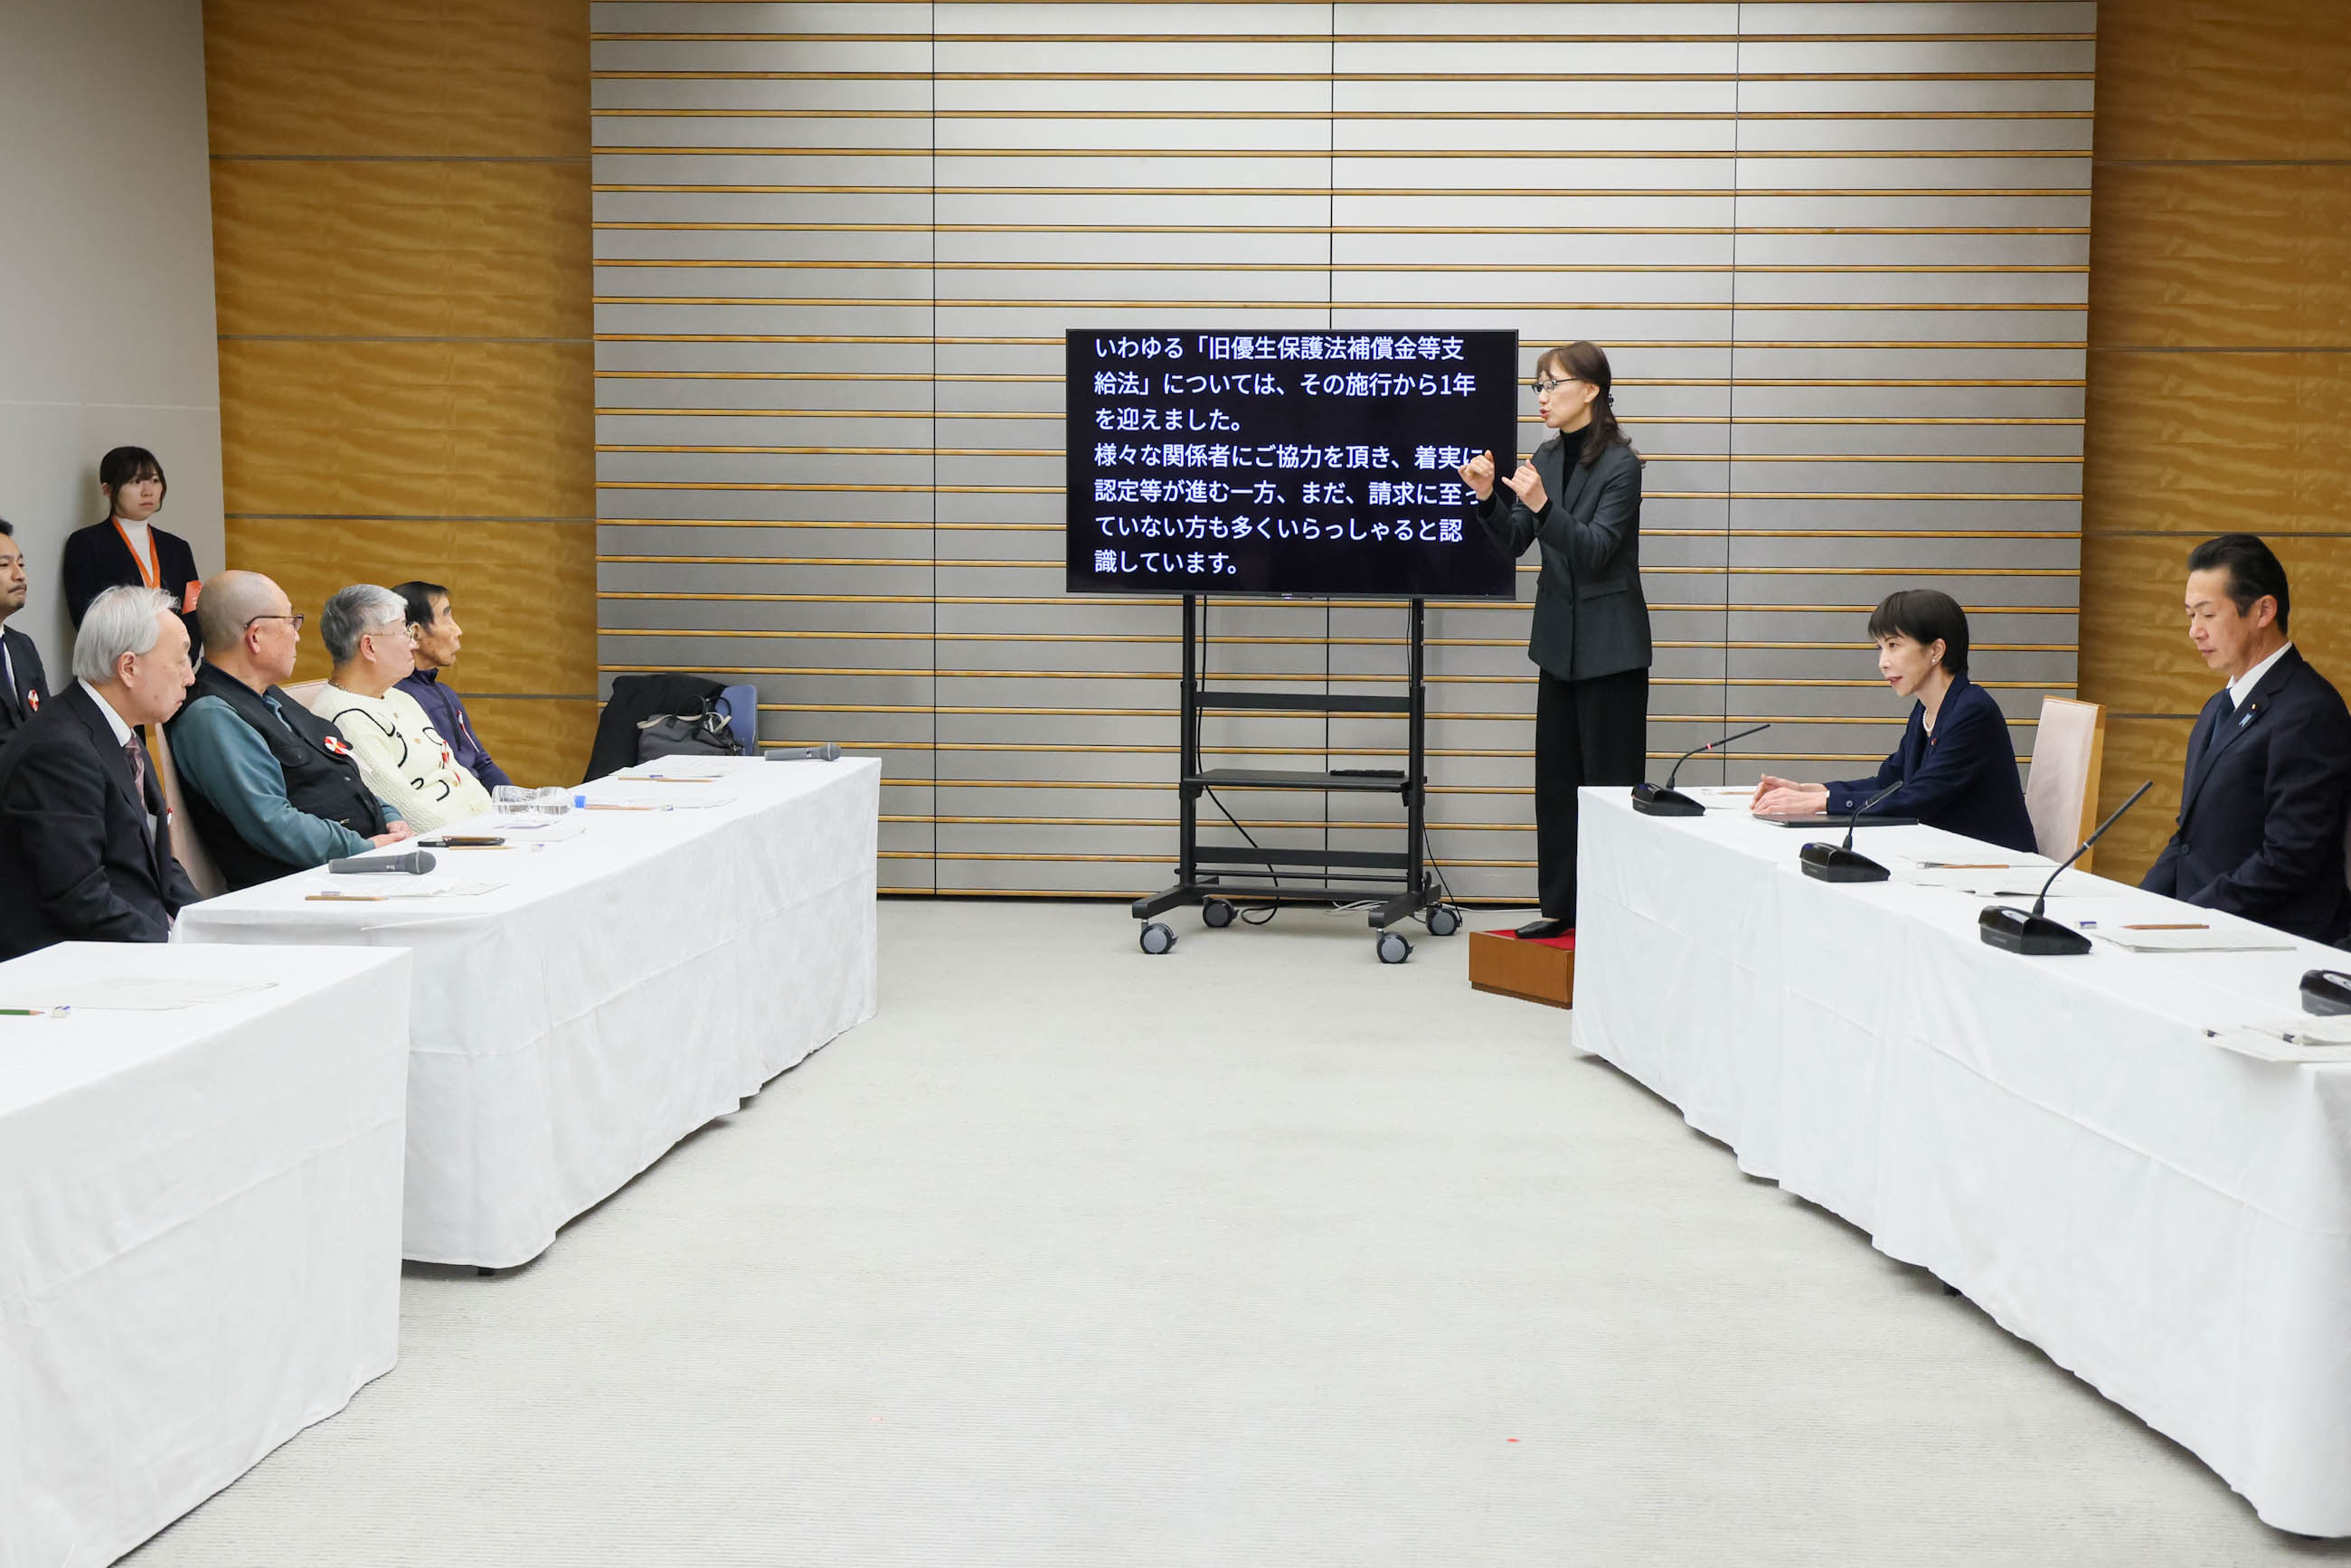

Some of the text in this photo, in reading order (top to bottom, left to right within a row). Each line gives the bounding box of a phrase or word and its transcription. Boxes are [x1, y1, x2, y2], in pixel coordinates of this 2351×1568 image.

[1096, 335, 1465, 360] いわゆる「旧優生保護法補償金等支
[1094, 372, 1477, 397] 給法」については、その施行から1年
[1096, 408, 1241, 431] を迎えました。
[1095, 515, 1463, 542] ていない方も多くいらっしゃると認
[1094, 550, 1237, 575] 識しています。
